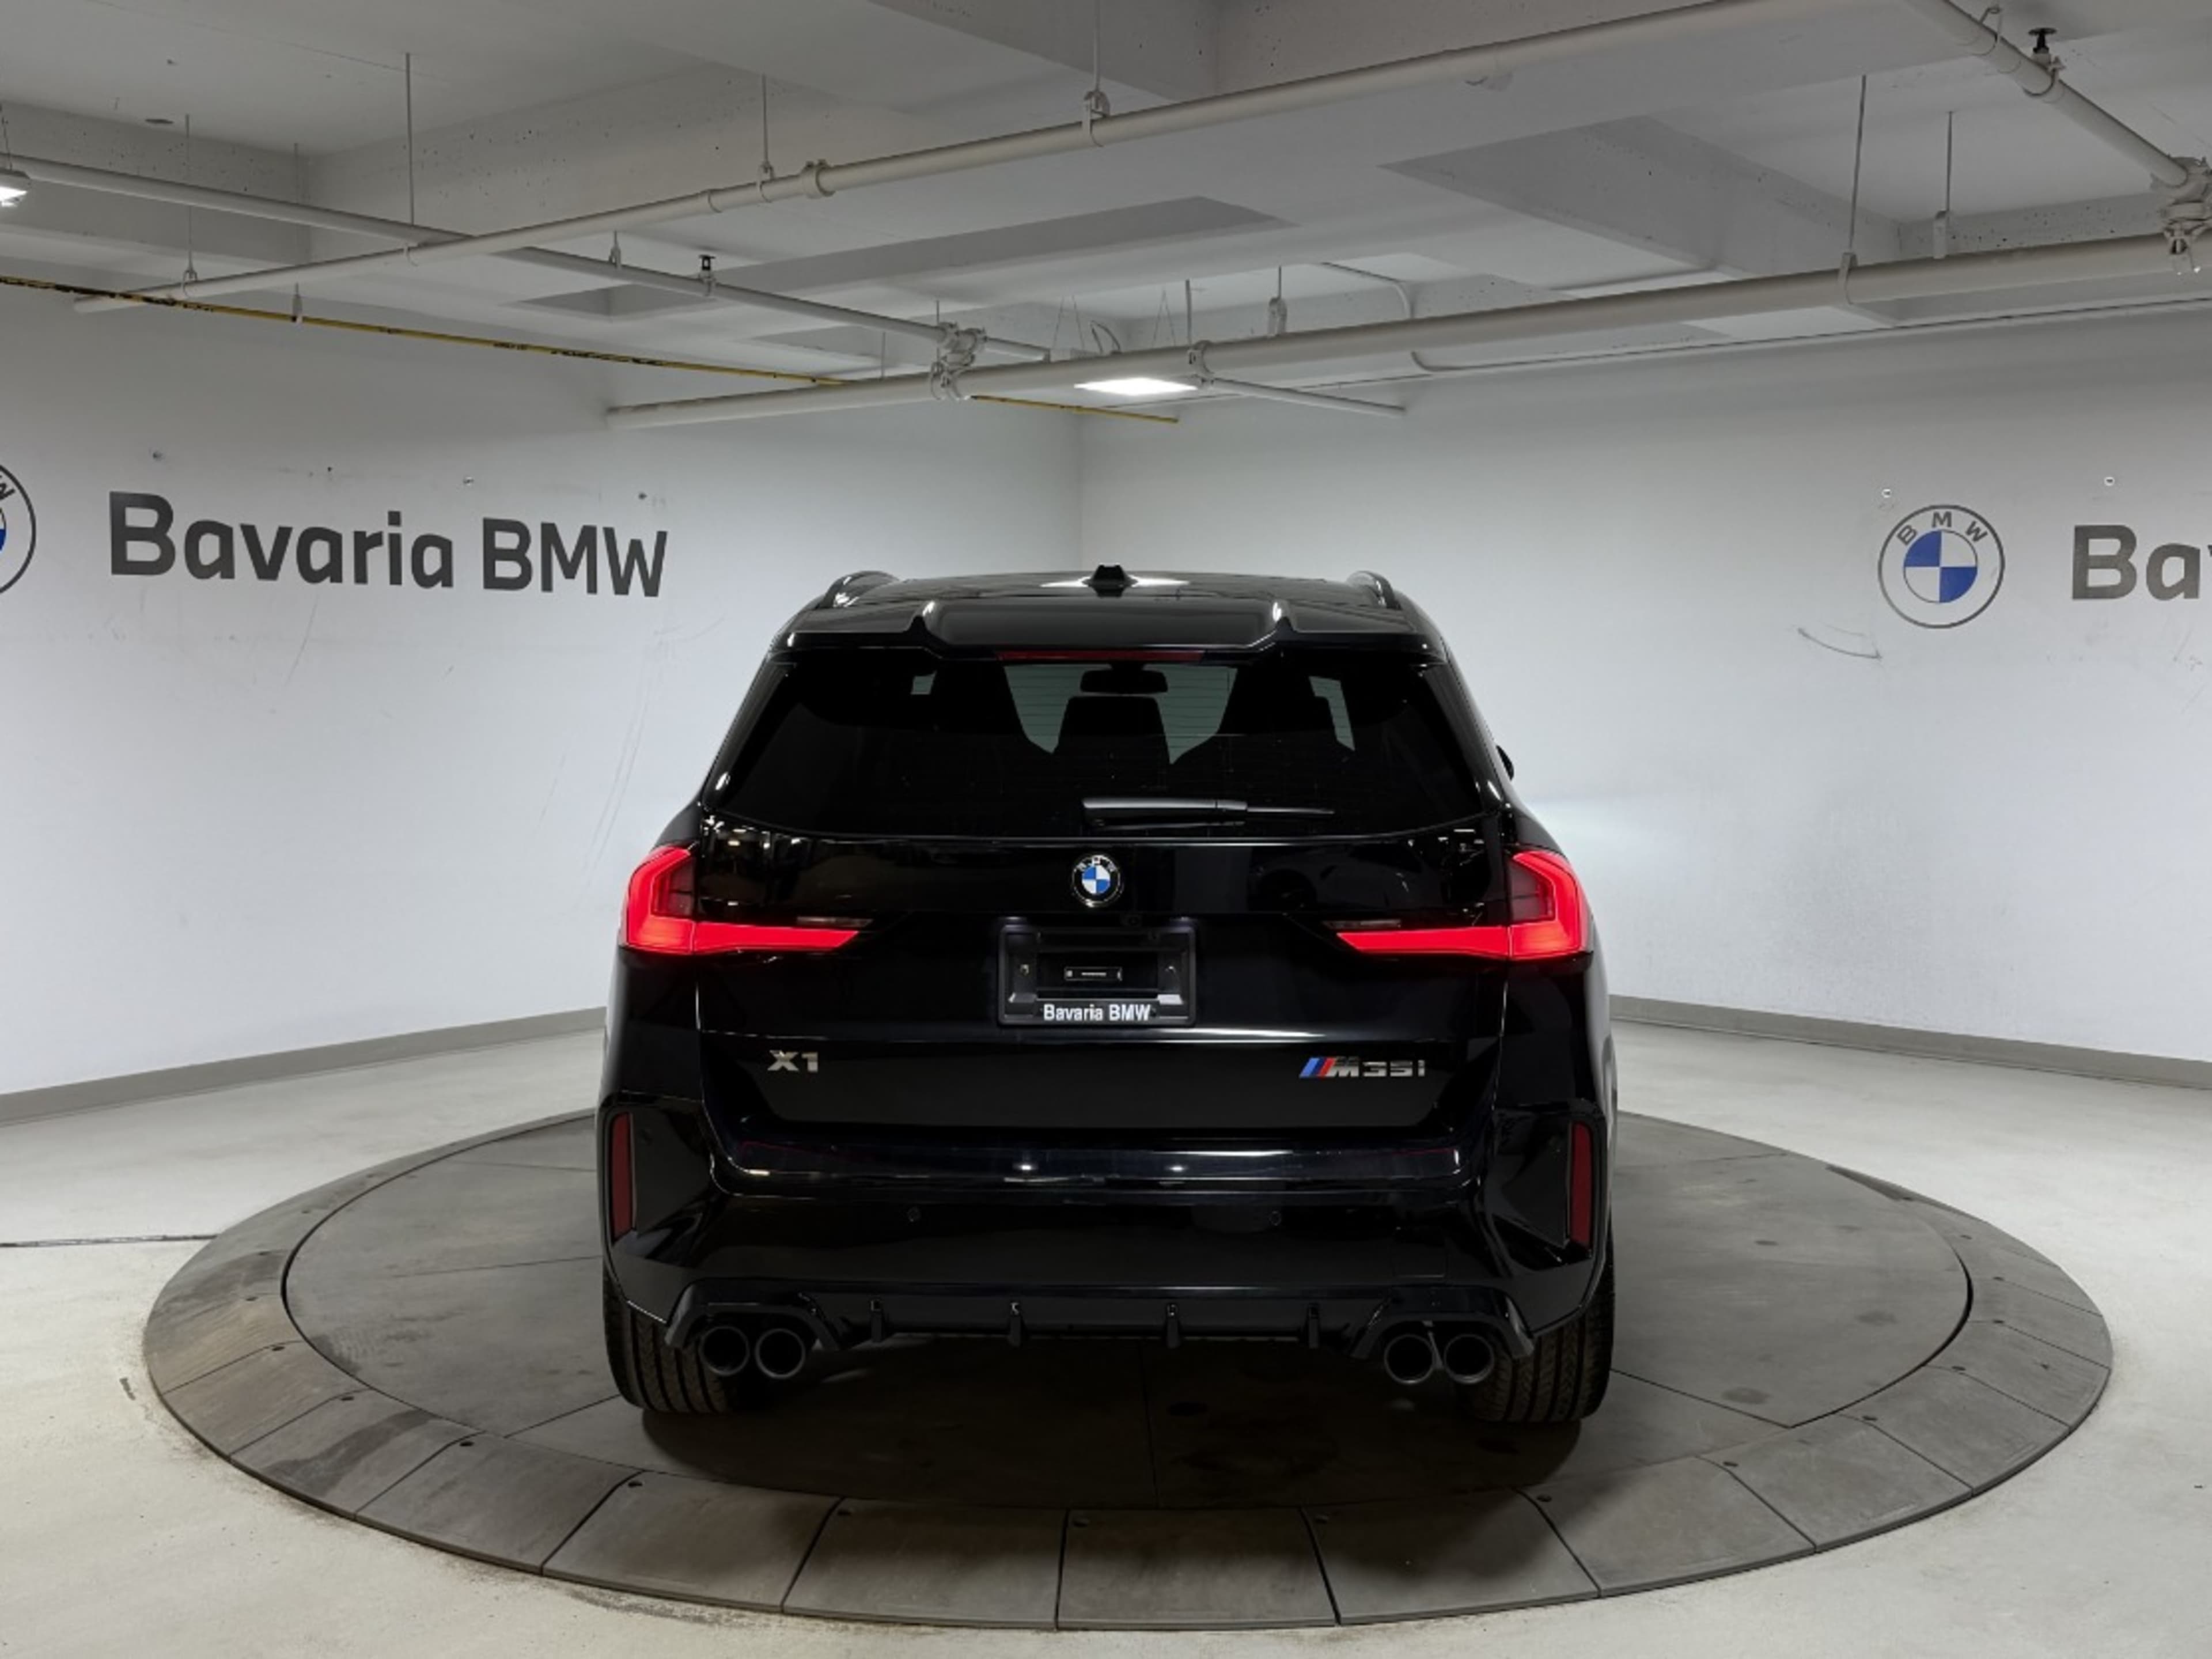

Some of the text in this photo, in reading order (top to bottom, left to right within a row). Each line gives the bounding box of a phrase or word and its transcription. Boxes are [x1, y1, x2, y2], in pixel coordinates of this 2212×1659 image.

[109, 491, 667, 597] Bavaria BMW
[1896, 511, 1988, 546] BMW
[2072, 525, 2212, 600] Ba
[1044, 1003, 1151, 1021] Bavaria BMW
[767, 1050, 818, 1072] X1
